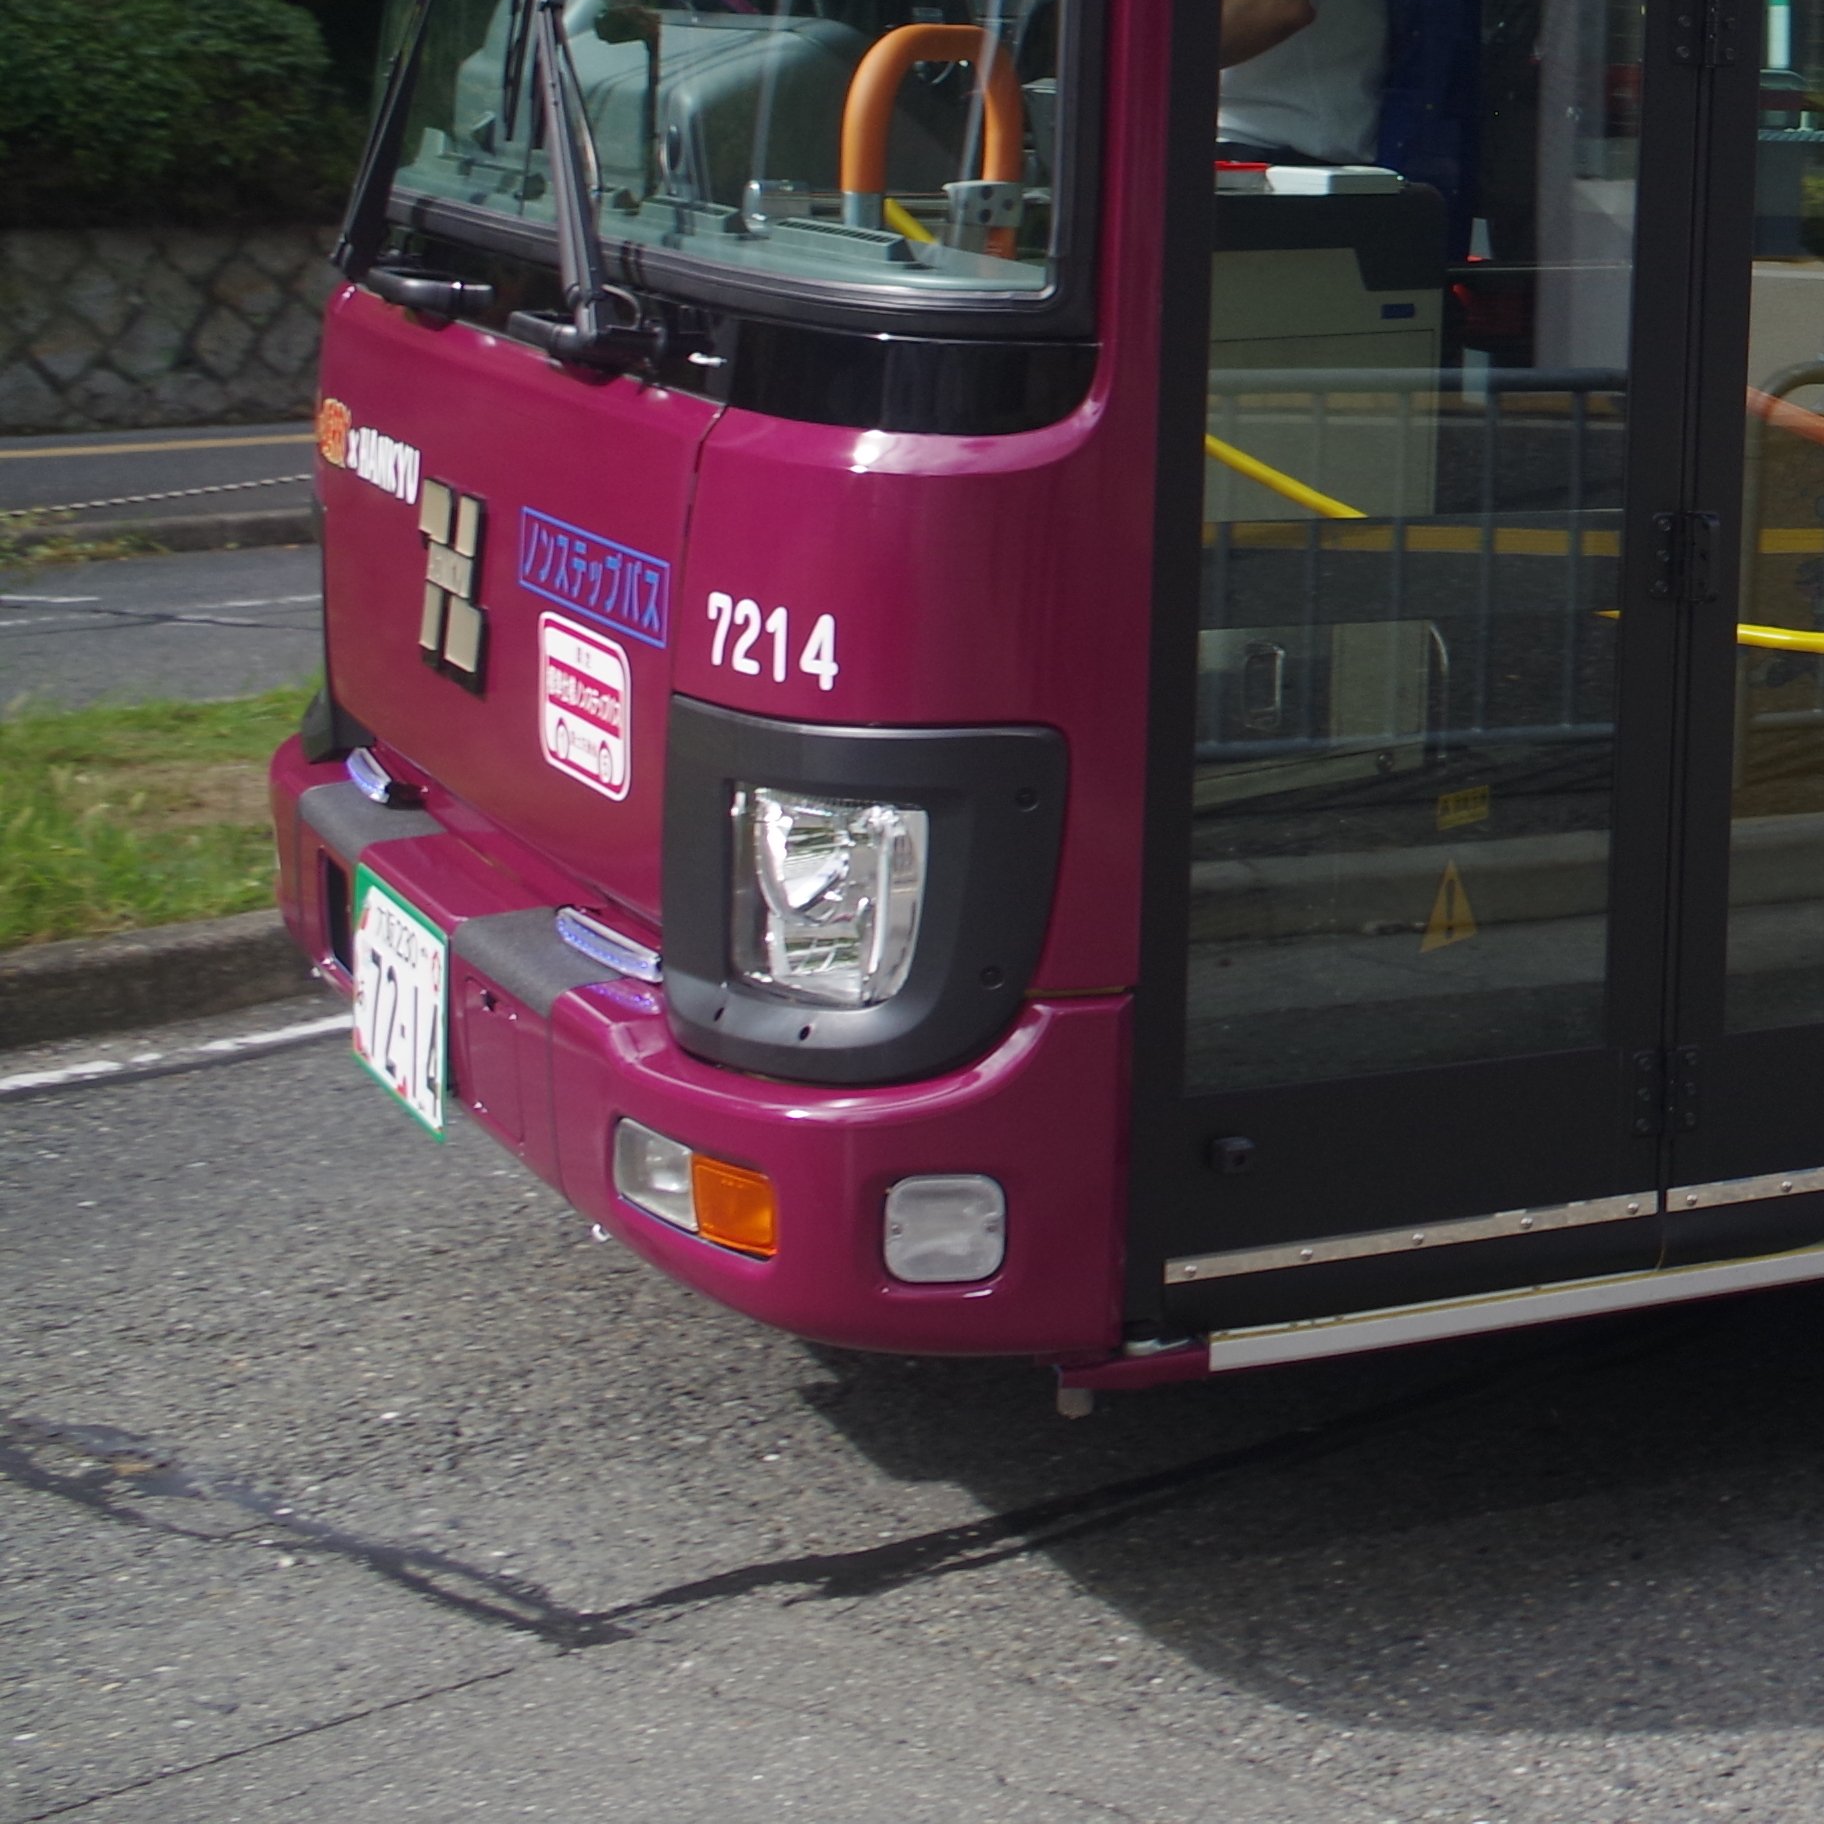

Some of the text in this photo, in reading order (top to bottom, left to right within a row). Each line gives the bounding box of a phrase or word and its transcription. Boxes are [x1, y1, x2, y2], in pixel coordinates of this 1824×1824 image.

[524, 522, 661, 633] ノンステップバス
[706, 590, 840, 692] 7214
